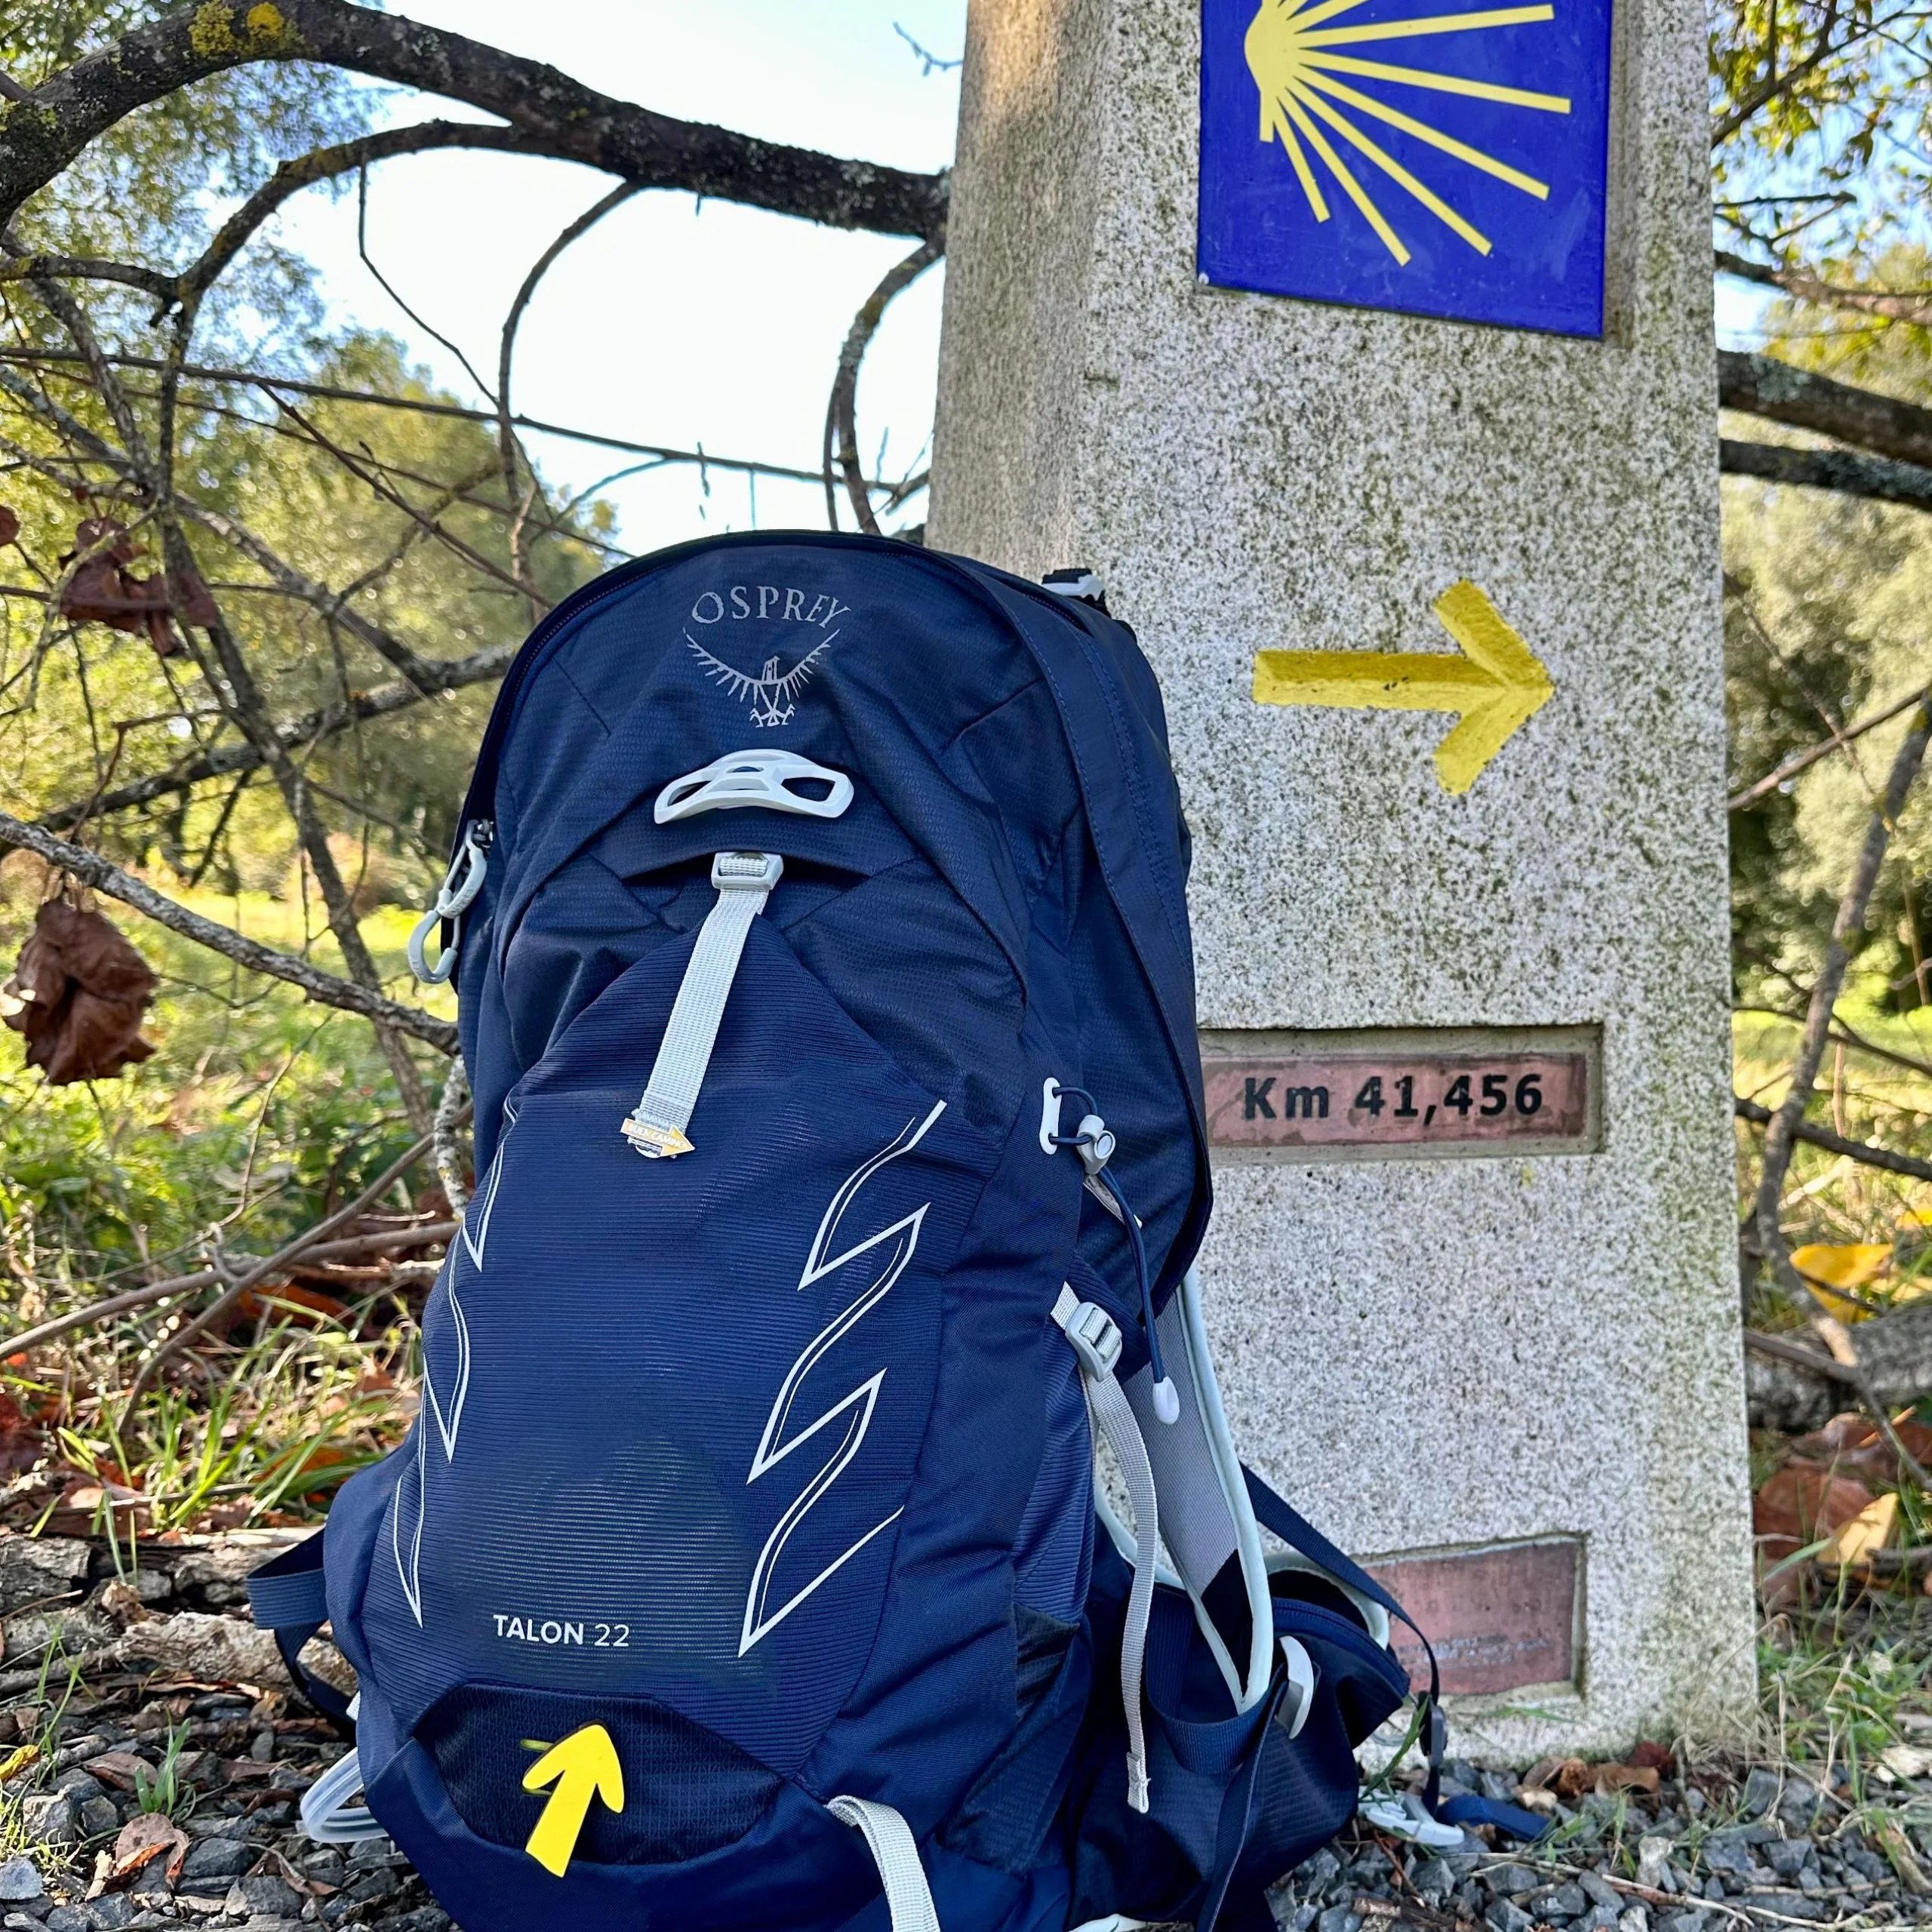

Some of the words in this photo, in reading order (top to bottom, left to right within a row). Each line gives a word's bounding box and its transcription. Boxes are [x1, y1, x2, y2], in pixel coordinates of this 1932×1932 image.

[692, 586, 852, 628] OSPREY
[1244, 1076, 1330, 1120] Km
[1354, 1074, 1542, 1127] 41,456
[493, 1614, 584, 1644] TALON
[594, 1623, 629, 1647] 22
